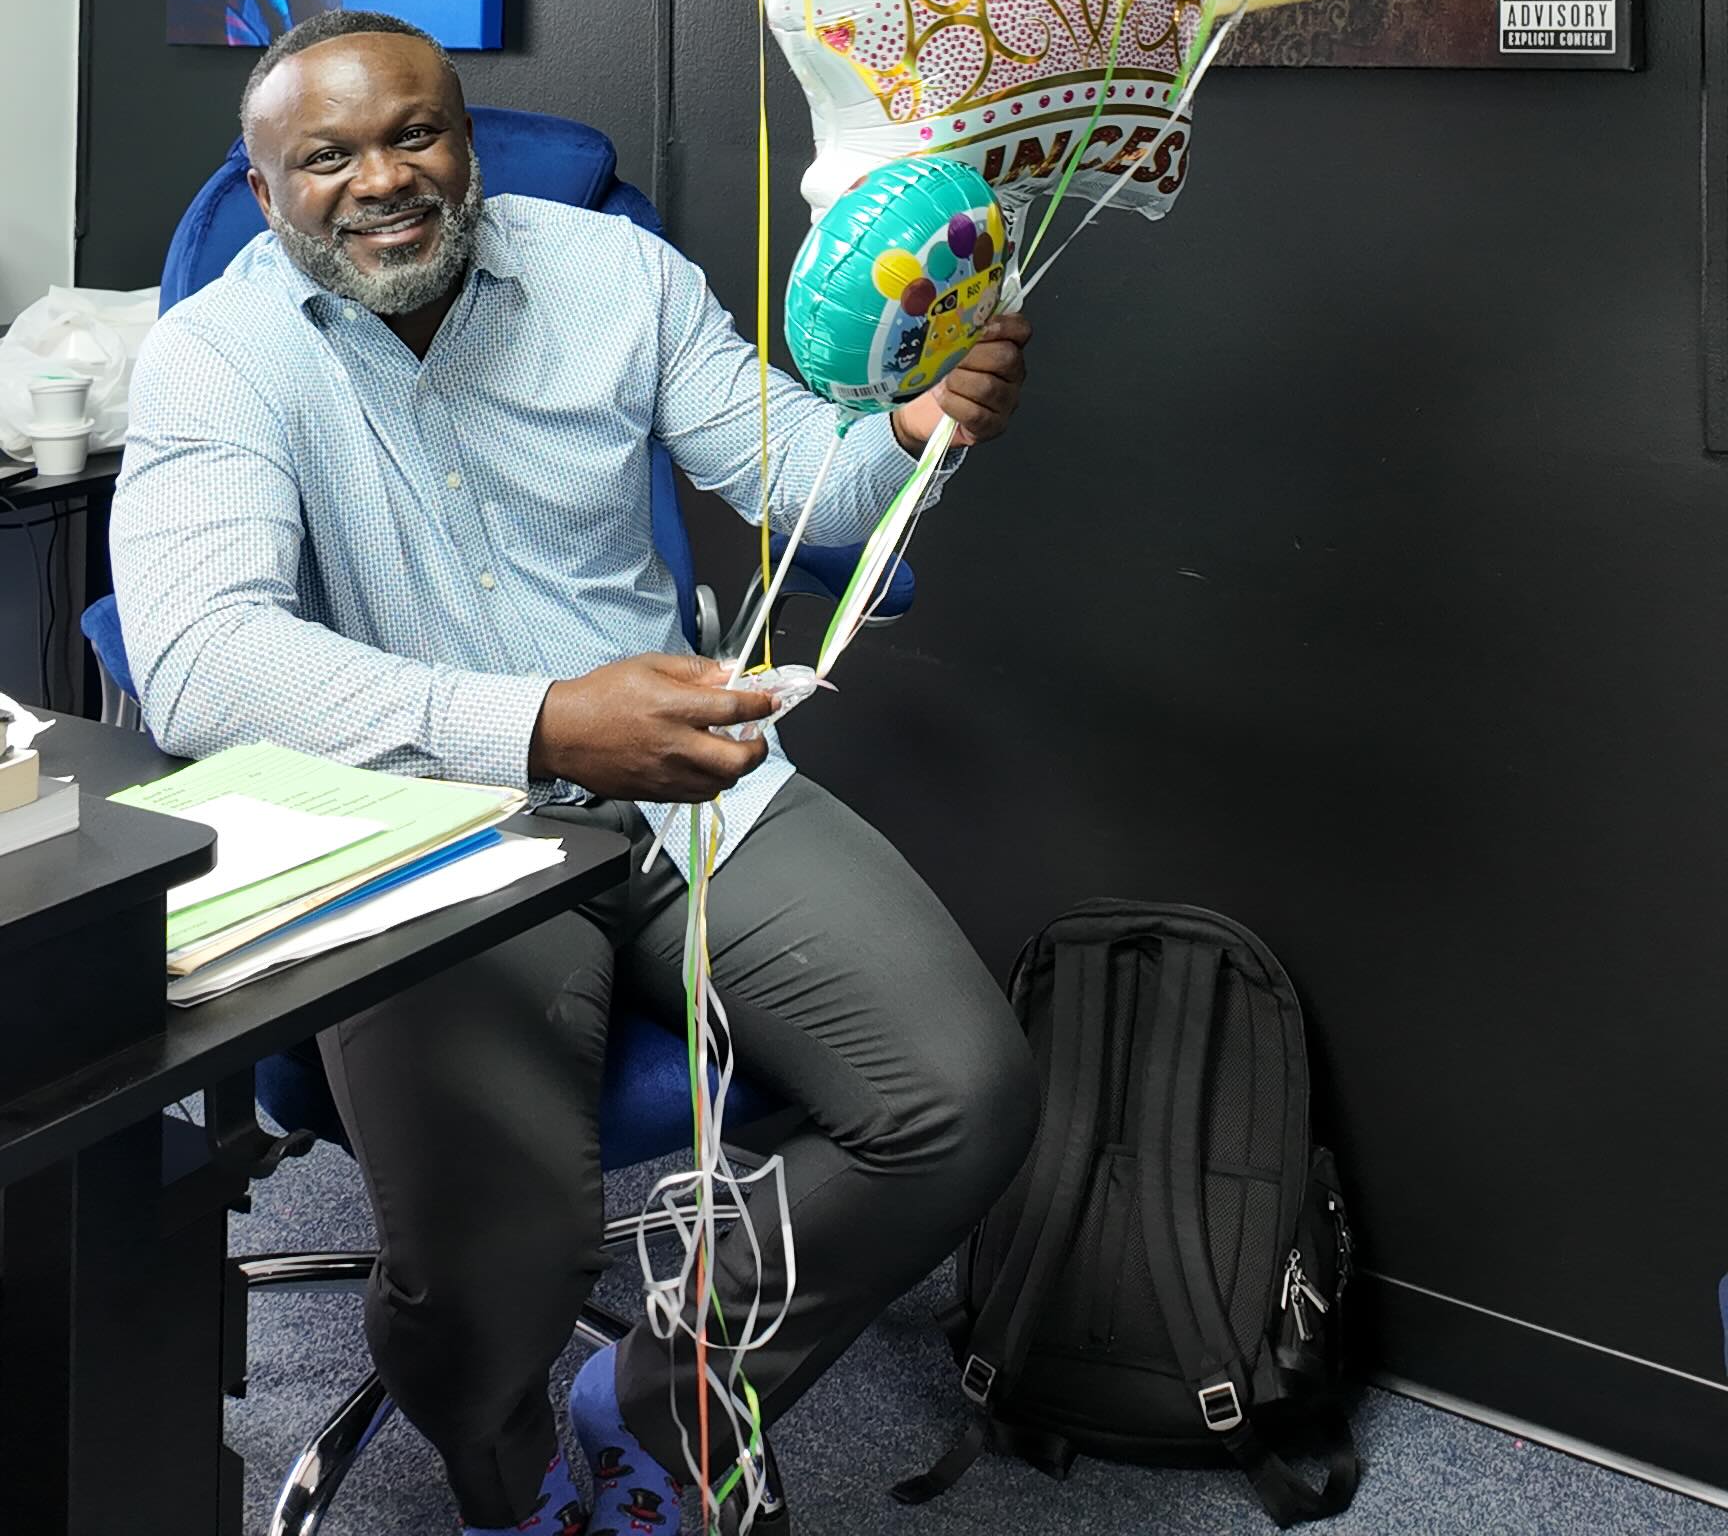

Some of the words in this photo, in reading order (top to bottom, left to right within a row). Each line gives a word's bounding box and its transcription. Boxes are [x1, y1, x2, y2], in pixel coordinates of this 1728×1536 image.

[1507, 4, 1607, 27] ADVISORY
[1508, 31, 1555, 46] EXPLICIT
[1559, 32, 1607, 46] CONTENT
